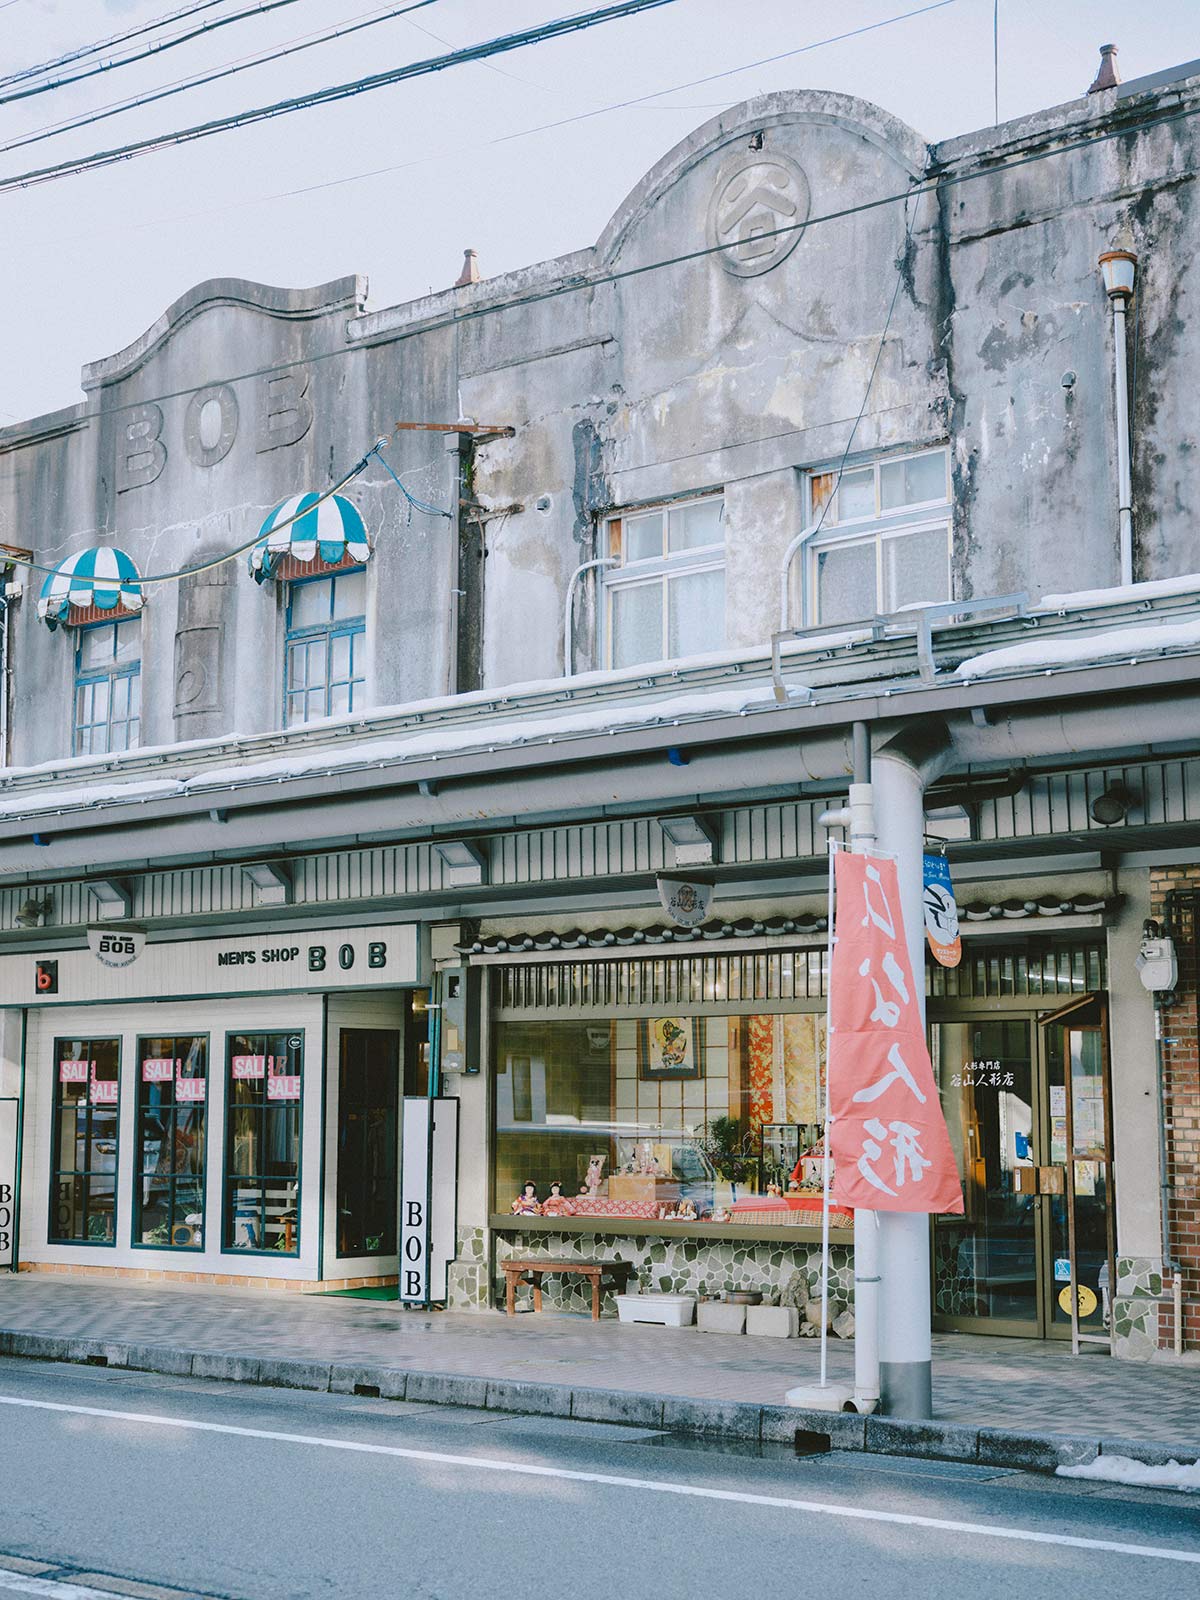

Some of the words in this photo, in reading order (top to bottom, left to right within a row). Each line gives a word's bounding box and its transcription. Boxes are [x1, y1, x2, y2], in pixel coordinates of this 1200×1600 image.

[116, 374, 314, 496] BOB
[99, 940, 135, 954] BOB
[217, 950, 256, 966] MEN'S
[261, 947, 300, 963] SHOP
[308, 941, 388, 972] BOB
[37, 966, 52, 990] b
[176, 1079, 206, 1098] SALE
[267, 1078, 301, 1097] SALE
[950, 1072, 1015, 1087] 谷山人形店
[90, 1082, 118, 1101] SALE
[404, 1201, 423, 1296] BOB
